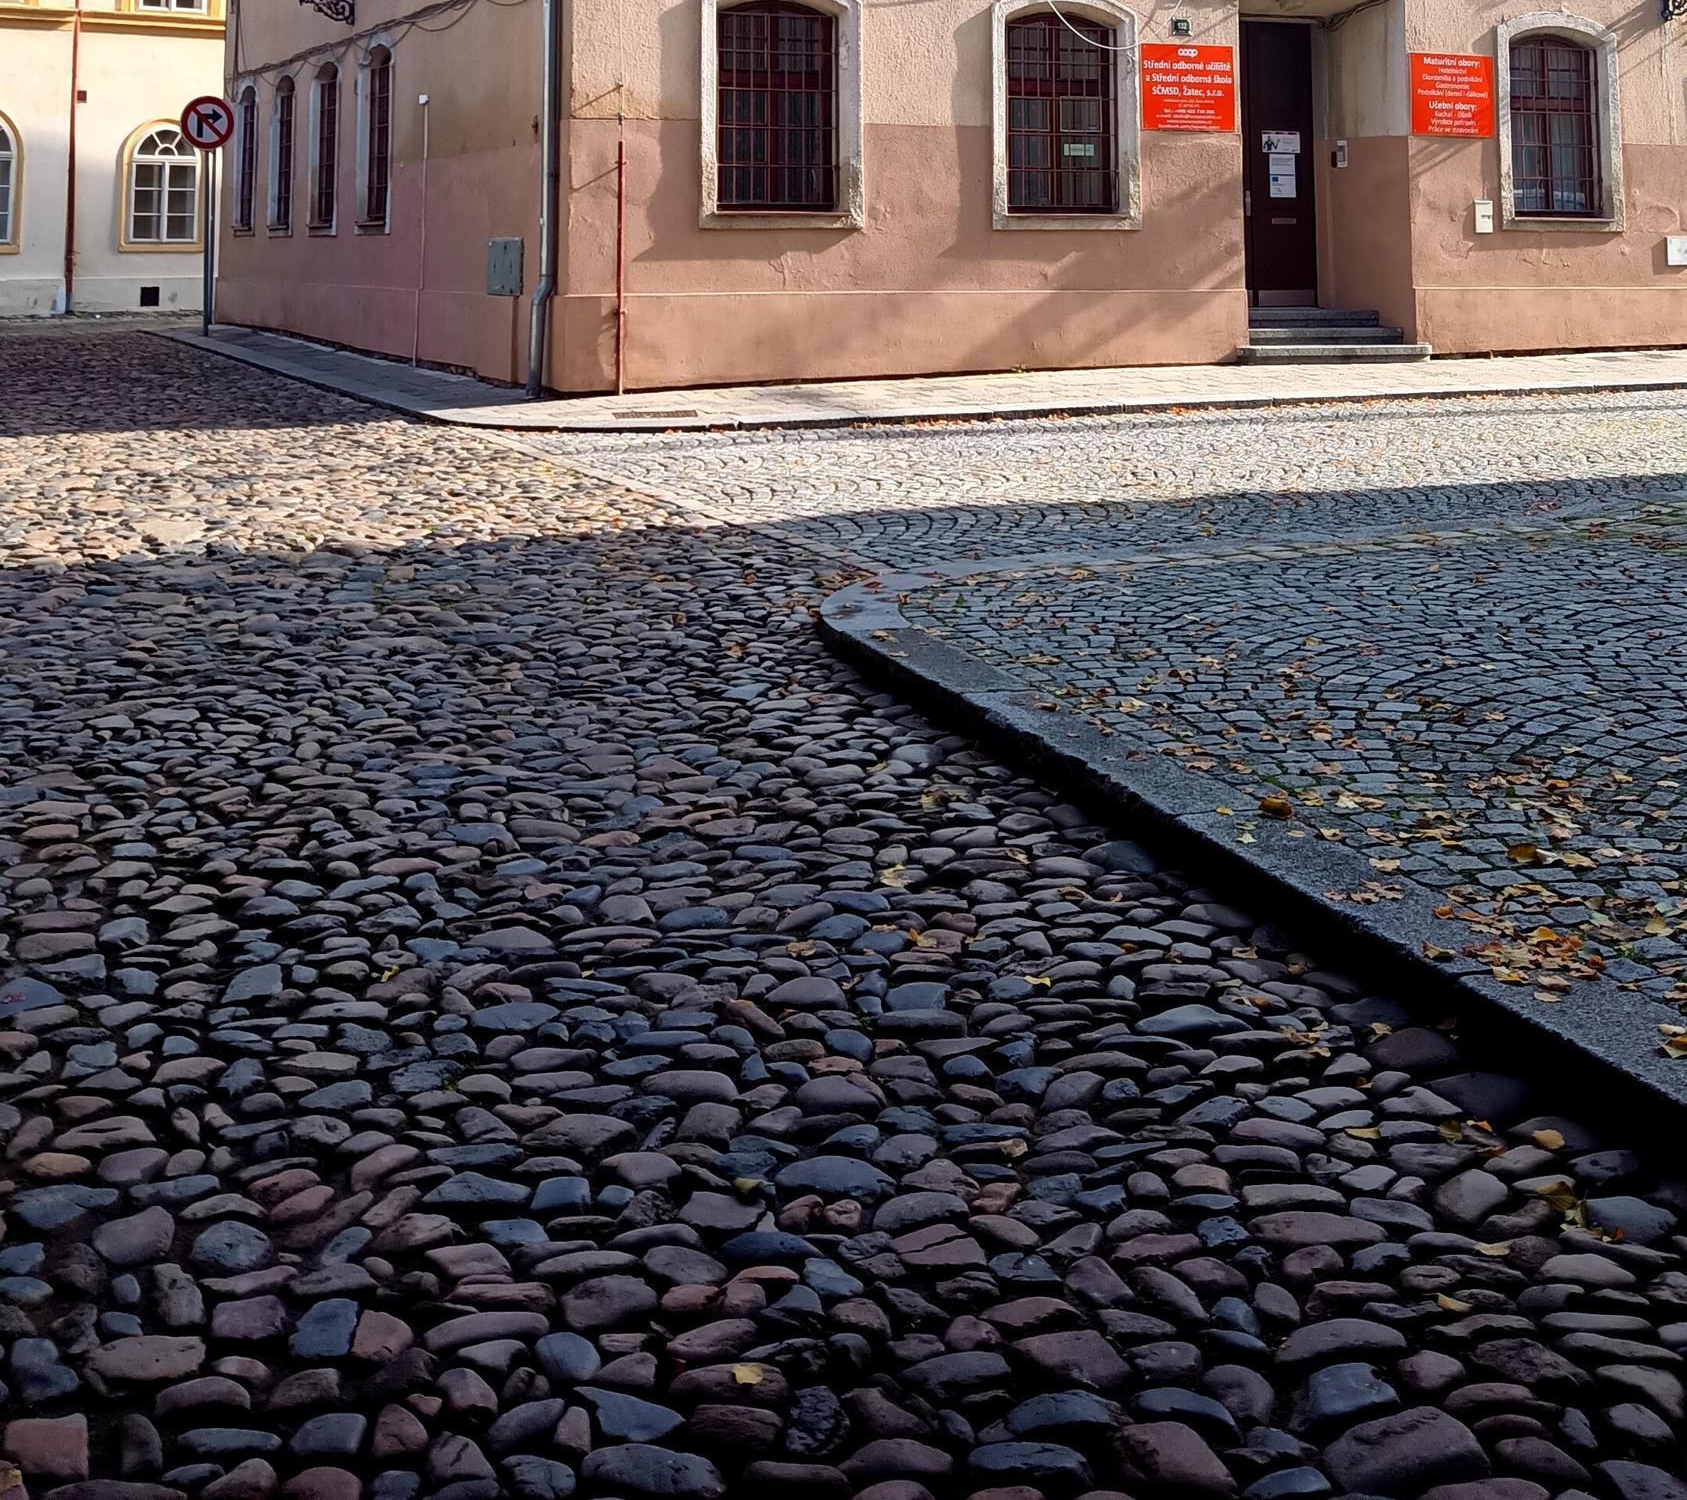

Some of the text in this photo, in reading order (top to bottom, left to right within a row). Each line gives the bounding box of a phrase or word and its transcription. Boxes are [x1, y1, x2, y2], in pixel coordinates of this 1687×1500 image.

[1178, 49, 1198, 58] coop
[1144, 60, 1231, 71] Střední odborné učiliště
[1424, 57, 1480, 68] Maturitní obory:
[1152, 73, 1179, 82] Střední
[1181, 74, 1212, 83] odborná
[1214, 75, 1232, 84] škola
[1152, 85, 1181, 96] SČMSD,
[1183, 85, 1205, 97] Žatec,
[1429, 101, 1477, 112] Učební obory:
[1431, 118, 1453, 126] Výrobce
